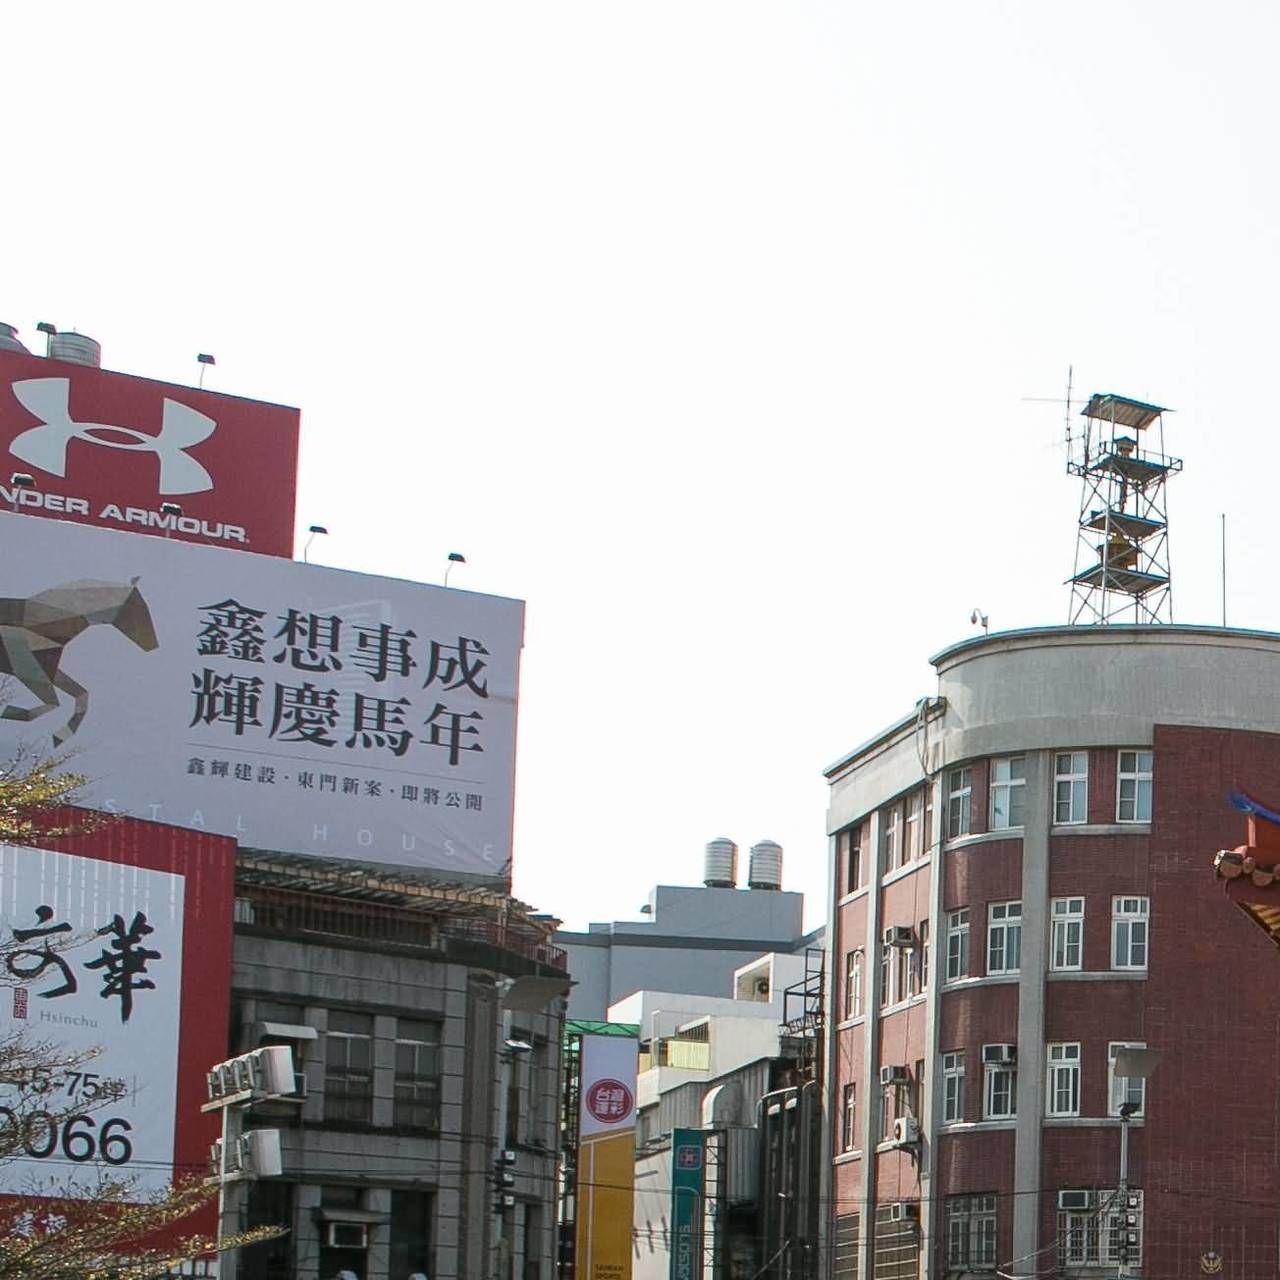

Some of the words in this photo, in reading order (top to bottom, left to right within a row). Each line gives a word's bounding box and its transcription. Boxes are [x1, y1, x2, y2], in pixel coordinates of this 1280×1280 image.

[197, 599, 491, 699] 鑫想事成
[189, 667, 485, 766] 輝慶馬年
[312, 823, 495, 862] HOUSE
[40, 1010, 99, 1029] Hsinchu
